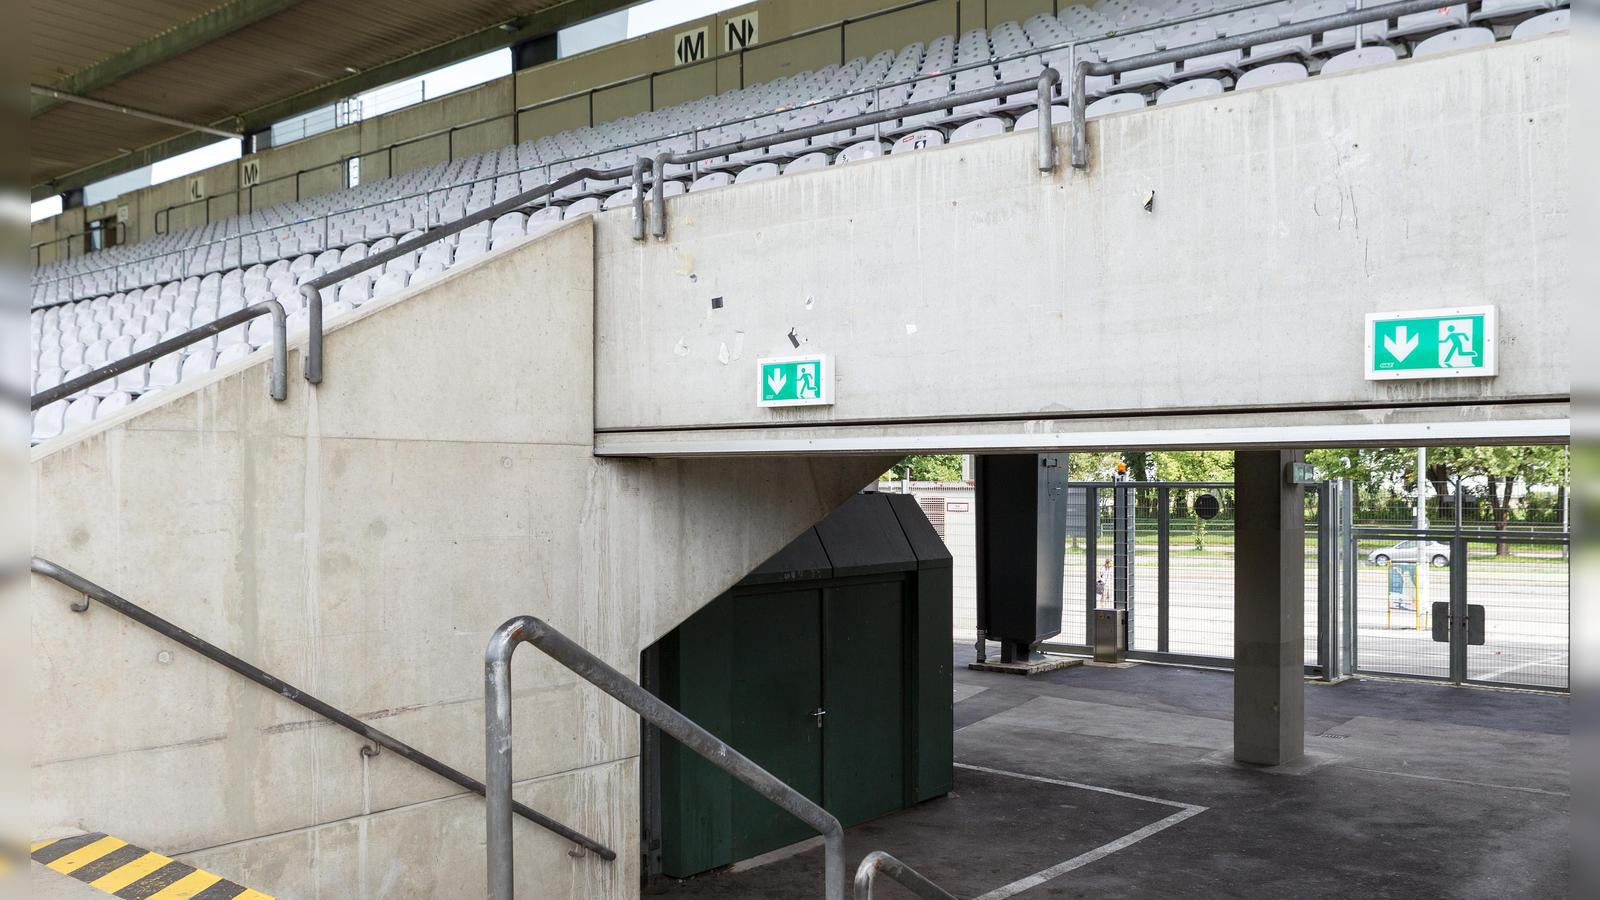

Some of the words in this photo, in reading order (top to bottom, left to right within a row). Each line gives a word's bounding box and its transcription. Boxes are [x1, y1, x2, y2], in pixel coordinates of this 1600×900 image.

[684, 31, 705, 64] M
[728, 19, 747, 51] N
[244, 163, 255, 185] M
